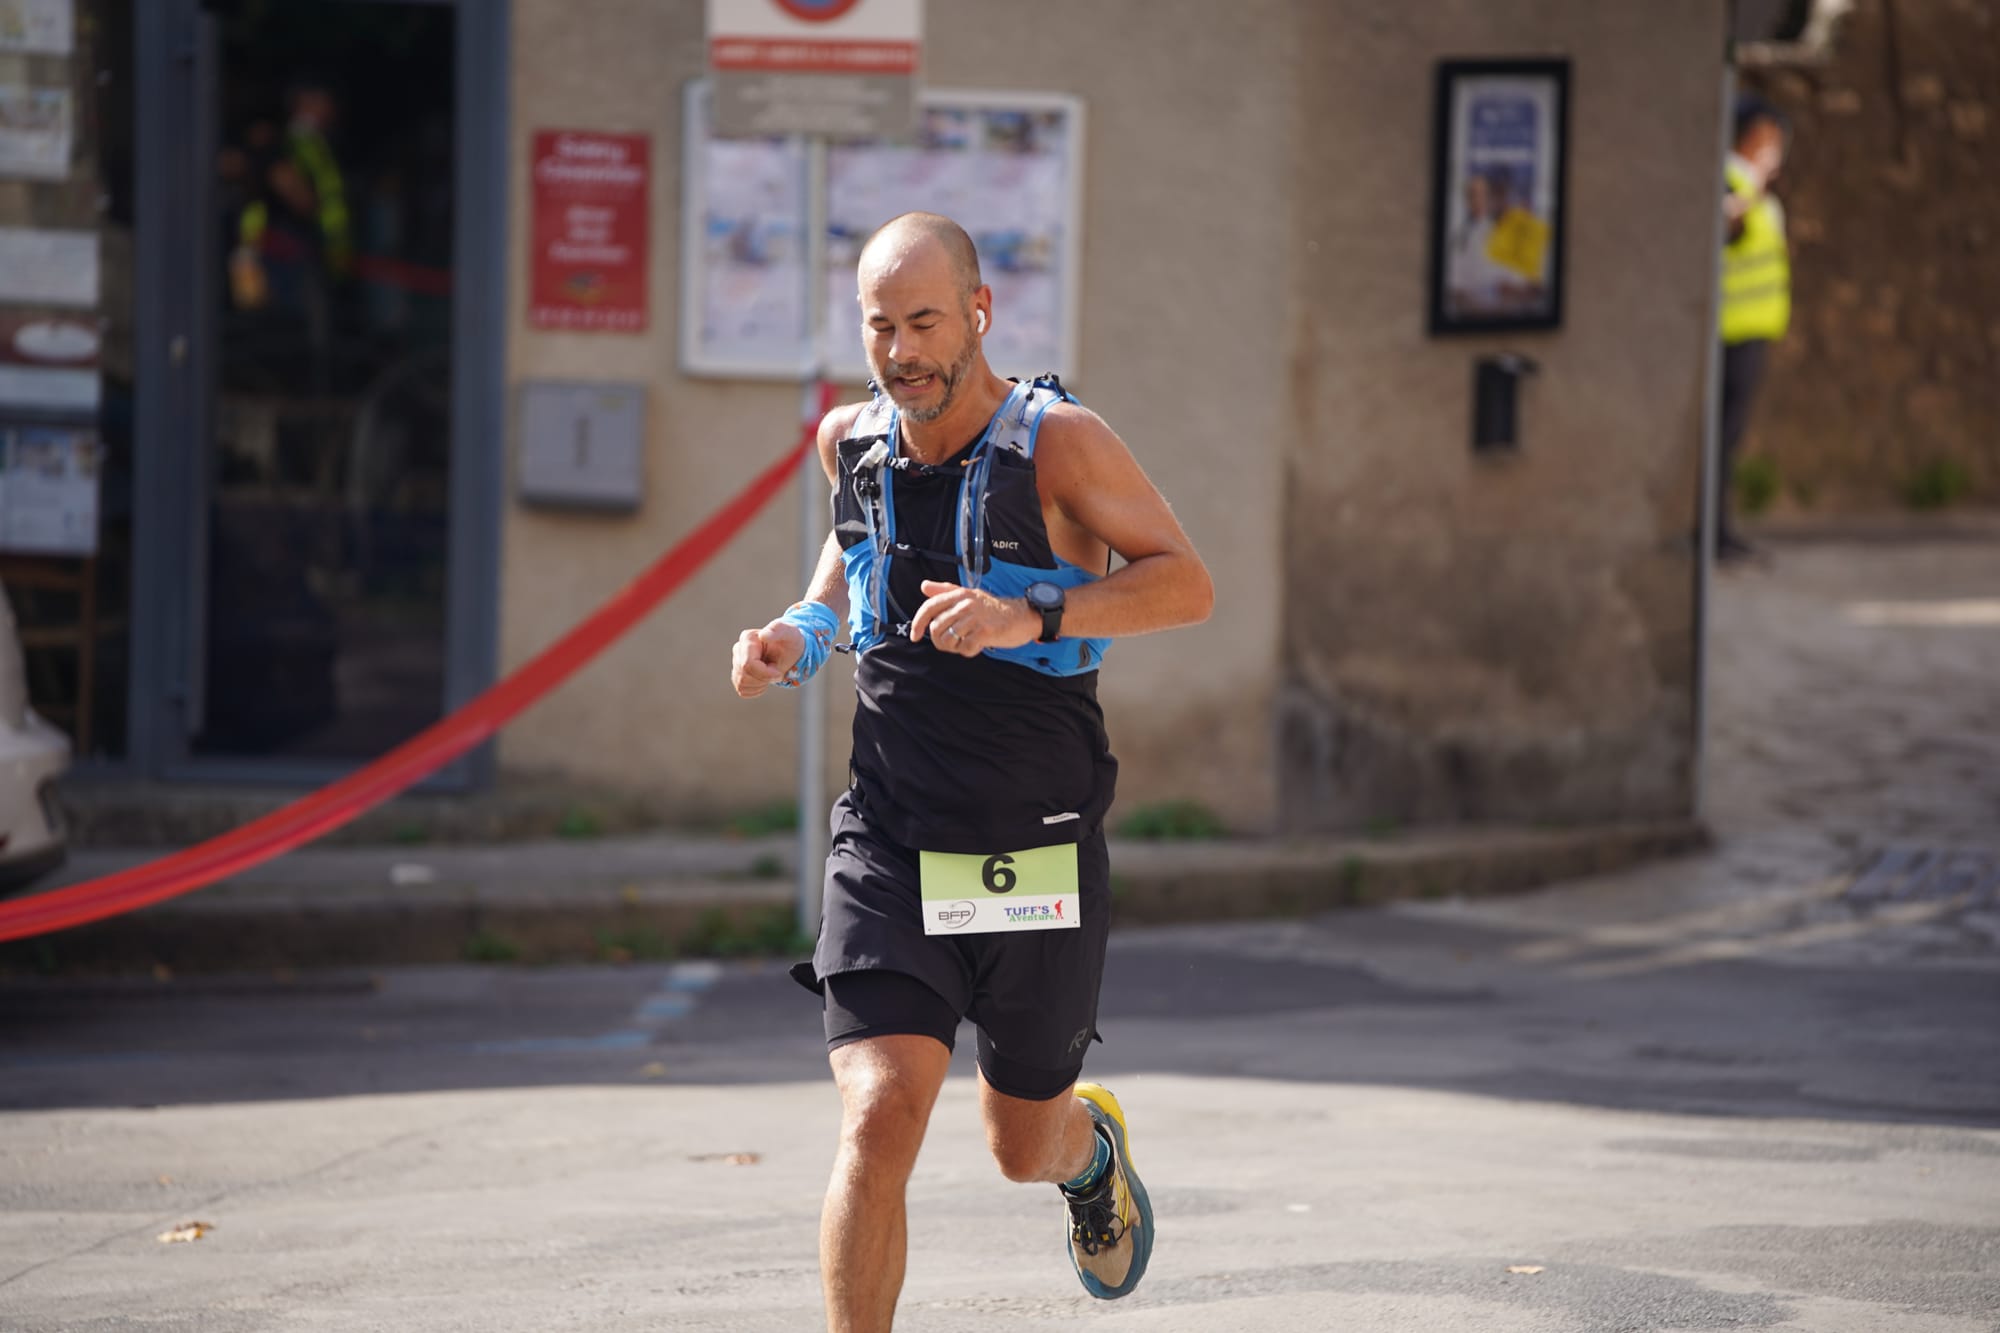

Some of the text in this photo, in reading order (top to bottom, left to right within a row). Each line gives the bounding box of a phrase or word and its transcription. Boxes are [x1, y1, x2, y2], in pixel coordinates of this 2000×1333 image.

[991, 540, 1019, 549] ADICT
[982, 854, 1017, 894] 6
[938, 910, 971, 920] BFP
[1004, 905, 1050, 917] TUFF'S
[1008, 913, 1055, 923] Aventure
